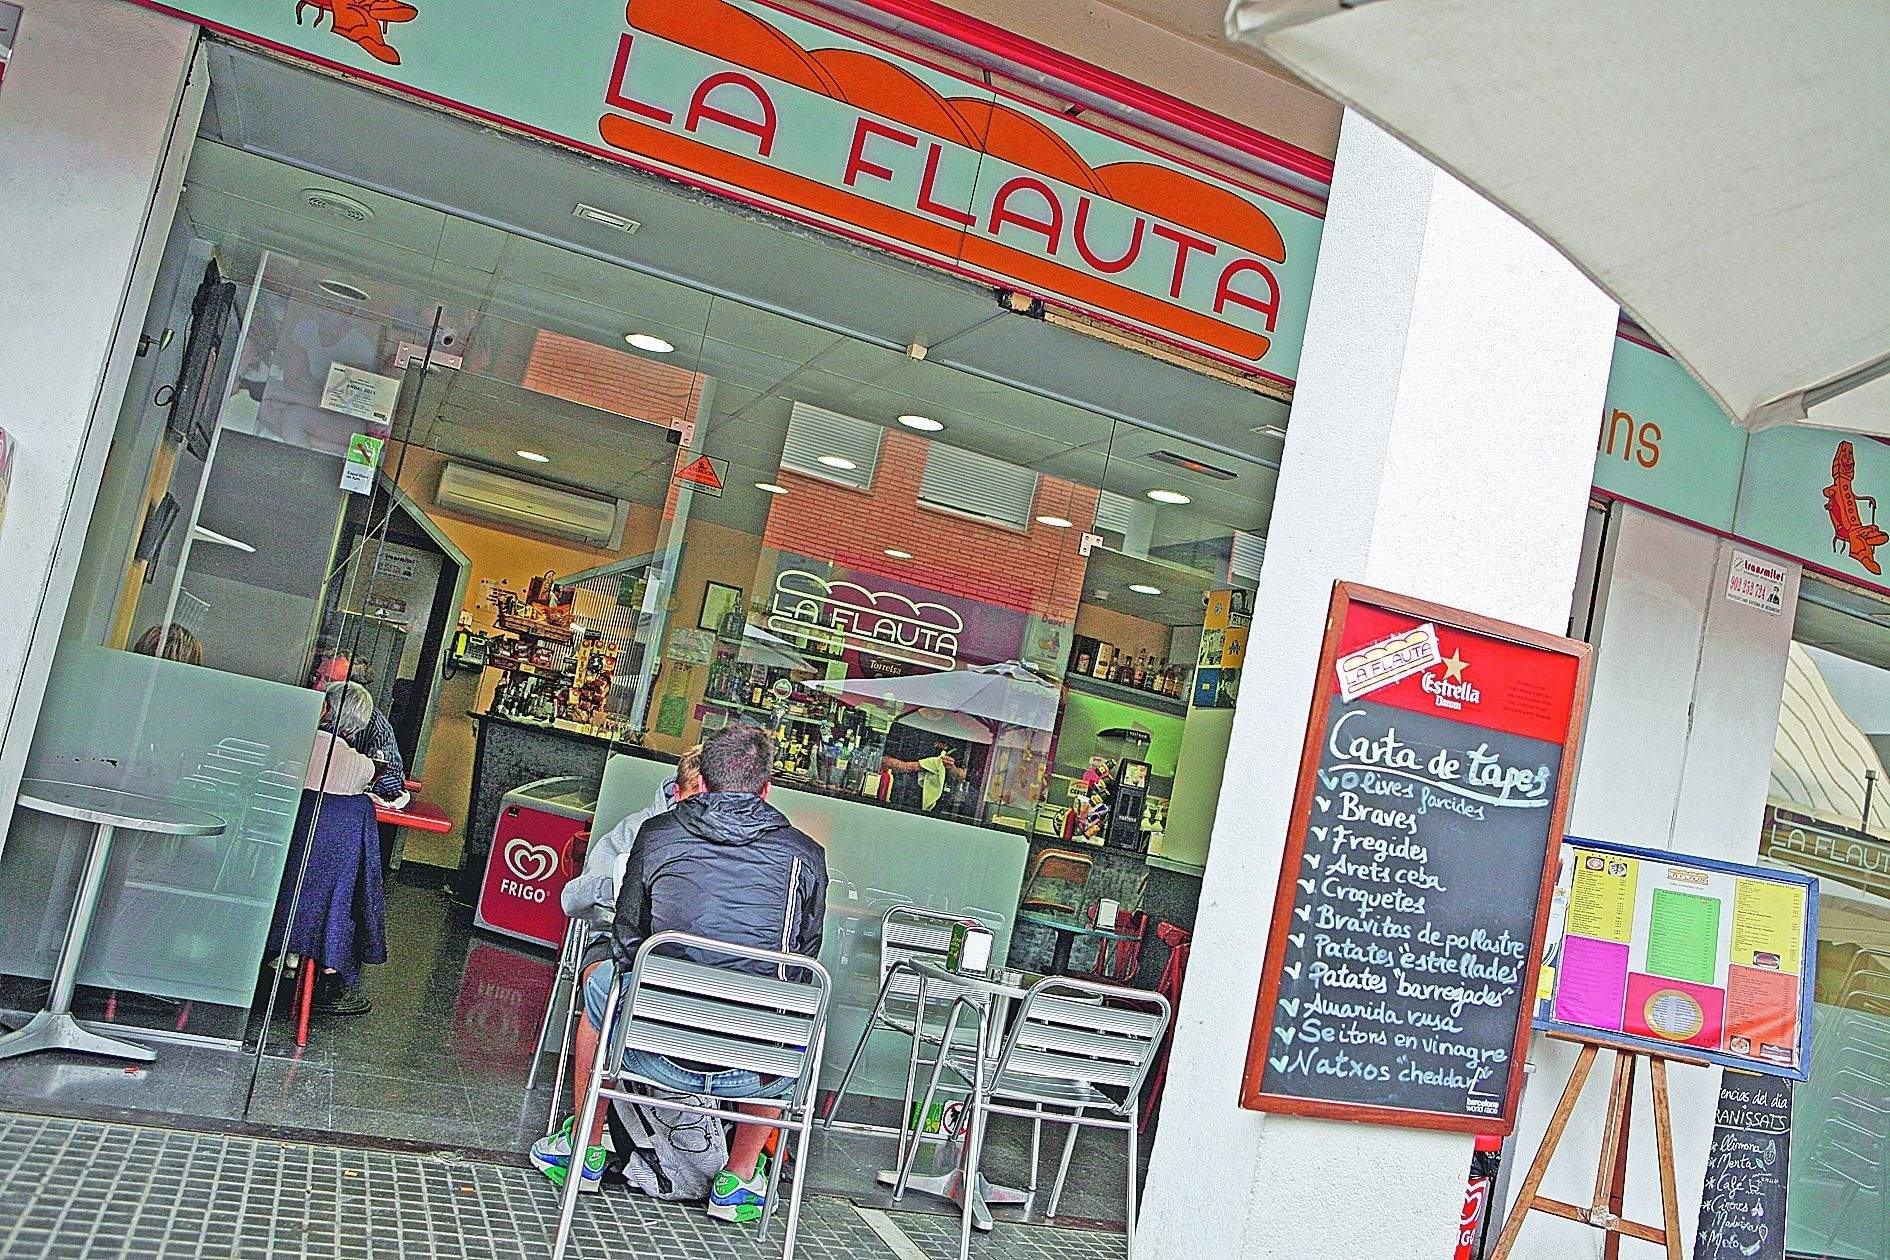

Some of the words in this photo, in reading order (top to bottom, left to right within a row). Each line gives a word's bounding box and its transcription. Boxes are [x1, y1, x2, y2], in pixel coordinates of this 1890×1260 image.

[605, 33, 777, 157] LA
[842, 117, 1281, 334] FLAUTA
[1597, 407, 1662, 468] ns
[771, 593, 819, 624] LA
[830, 607, 958, 656] FLAUTA
[1345, 668, 1367, 685] LA
[1371, 642, 1432, 674] FLAUTA
[1421, 672, 1480, 704] Estrella
[1329, 710, 1423, 770] Carta
[1428, 749, 1461, 779] de
[1465, 742, 1550, 800] tapes
[1337, 791, 1418, 834] Braves
[1341, 771, 1414, 798] Olives
[1417, 786, 1486, 820] farcides
[1331, 825, 1428, 864] Fregides
[1770, 824, 1806, 852] LA
[1814, 835, 1890, 873] FLAUT
[500, 878, 546, 903] FRIGO
[1321, 877, 1426, 919] Croquetes
[1394, 866, 1447, 892] ceba
[1313, 933, 1395, 968] Patates
[1417, 921, 1445, 947] de
[1445, 928, 1525, 960] pollastre
[1308, 961, 1388, 994] Patates
[1303, 992, 1404, 1025] Amanida
[1407, 1009, 1463, 1034] rusa
[1287, 1046, 1391, 1082] Natxos
[1394, 1034, 1418, 1051] en
[1421, 1036, 1509, 1070] vinagre
[1715, 1104, 1788, 1130] RANISSATS
[1719, 1088, 1750, 1103] encias
[1752, 1090, 1768, 1107] del
